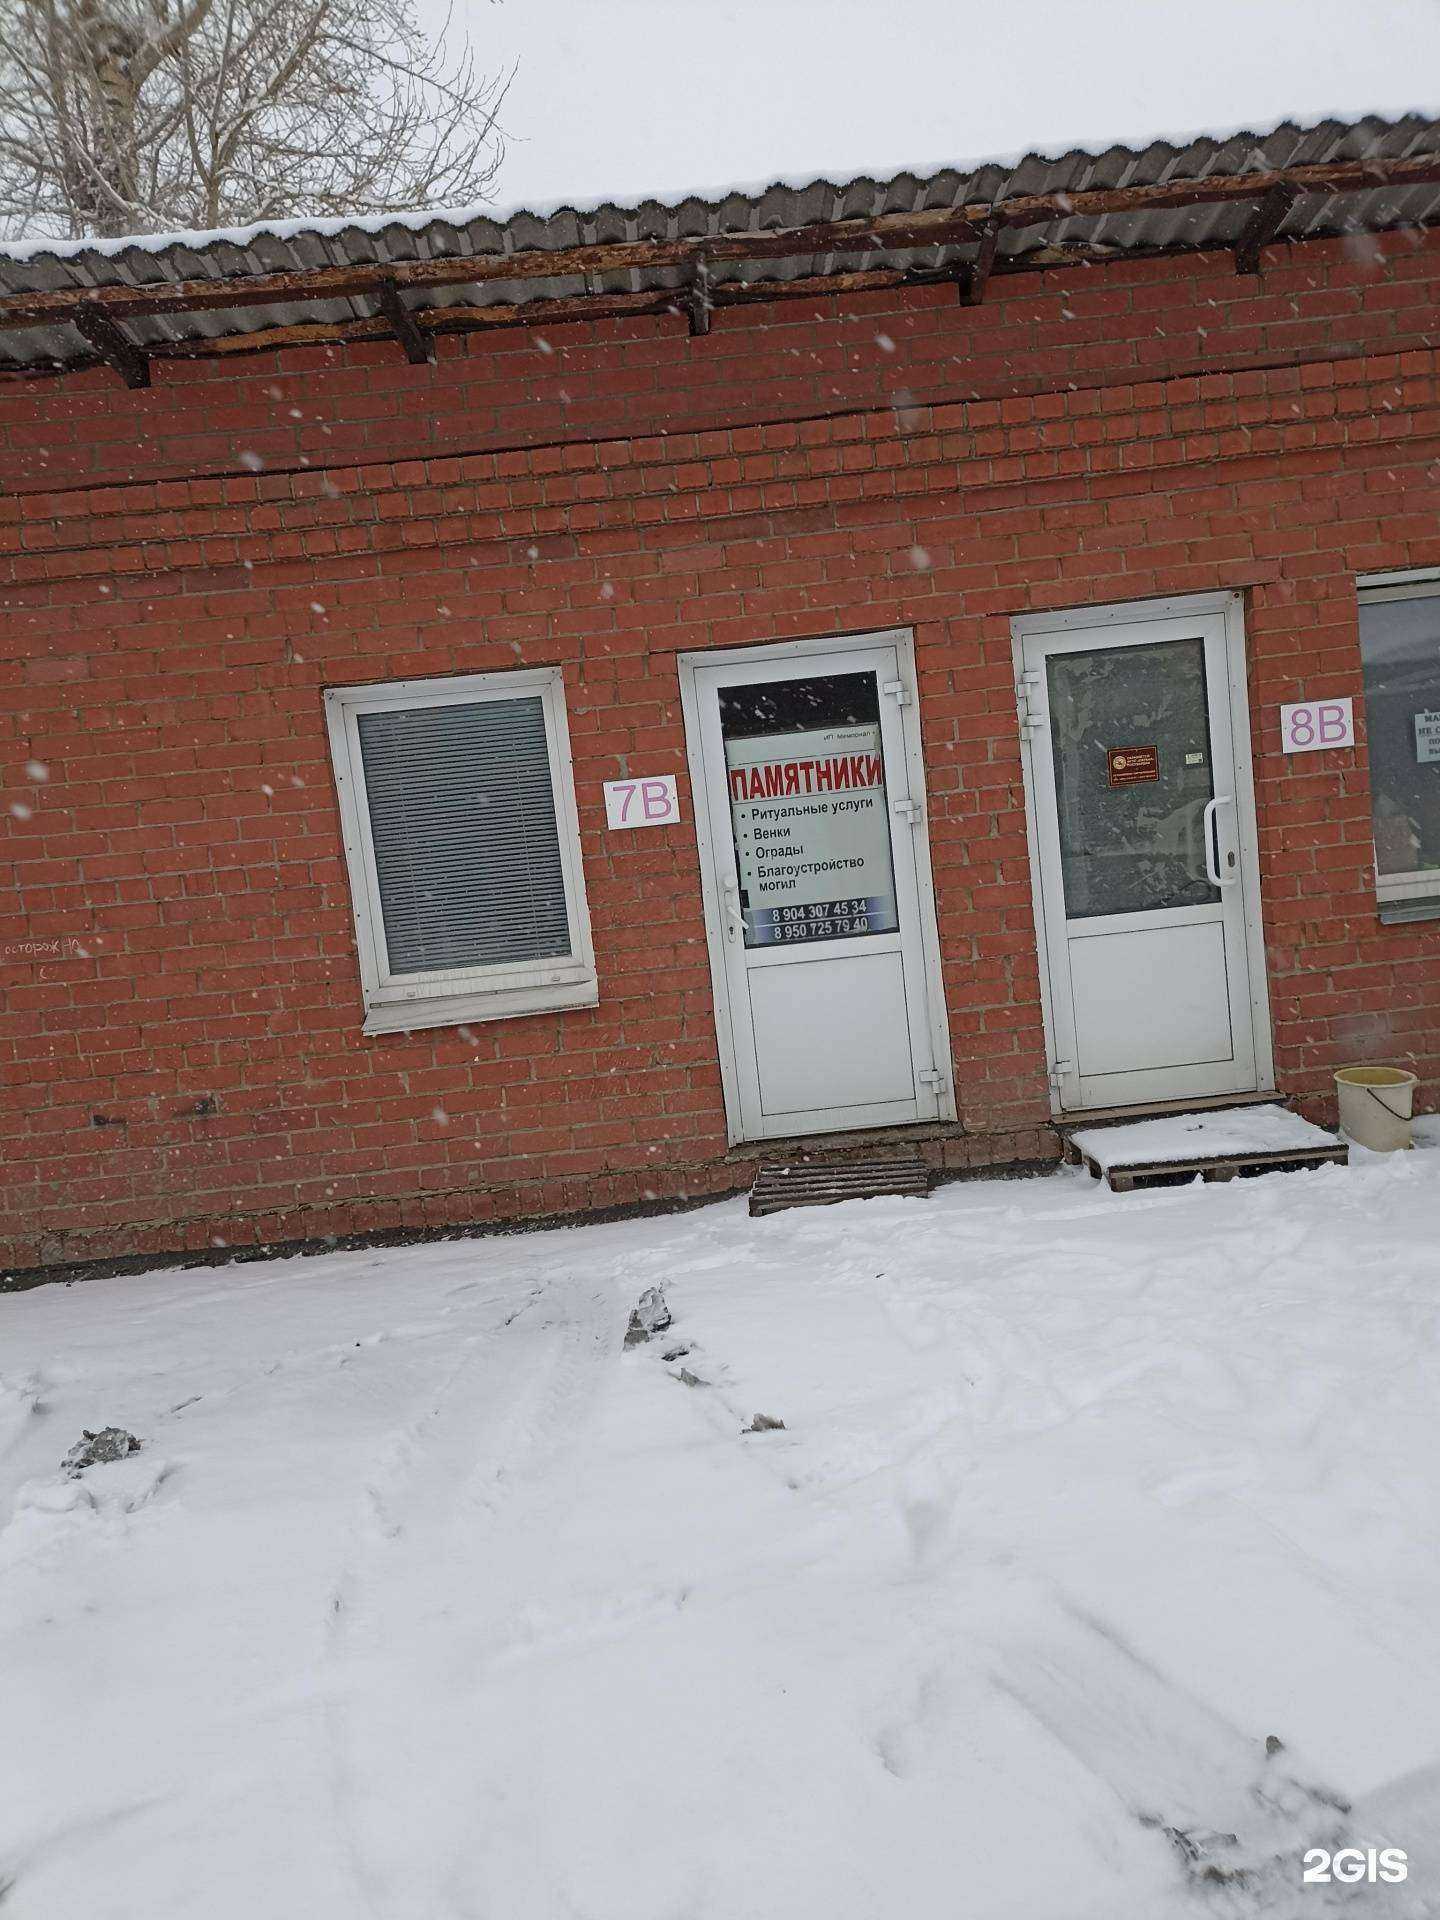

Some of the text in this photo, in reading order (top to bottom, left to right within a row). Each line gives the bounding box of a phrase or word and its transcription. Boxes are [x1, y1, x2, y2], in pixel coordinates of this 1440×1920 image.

[730, 753, 883, 801] ПАМЯТНИКИ
[751, 798, 874, 821] Ритуальные услуги
[753, 827, 791, 840] Венки
[755, 845, 804, 860] Ограды
[757, 857, 865, 878] Благоустройство
[759, 879, 797, 892] могил
[772, 899, 867, 922] 8 904 307 45 34
[774, 917, 868, 940] 8 950 725 79 40
